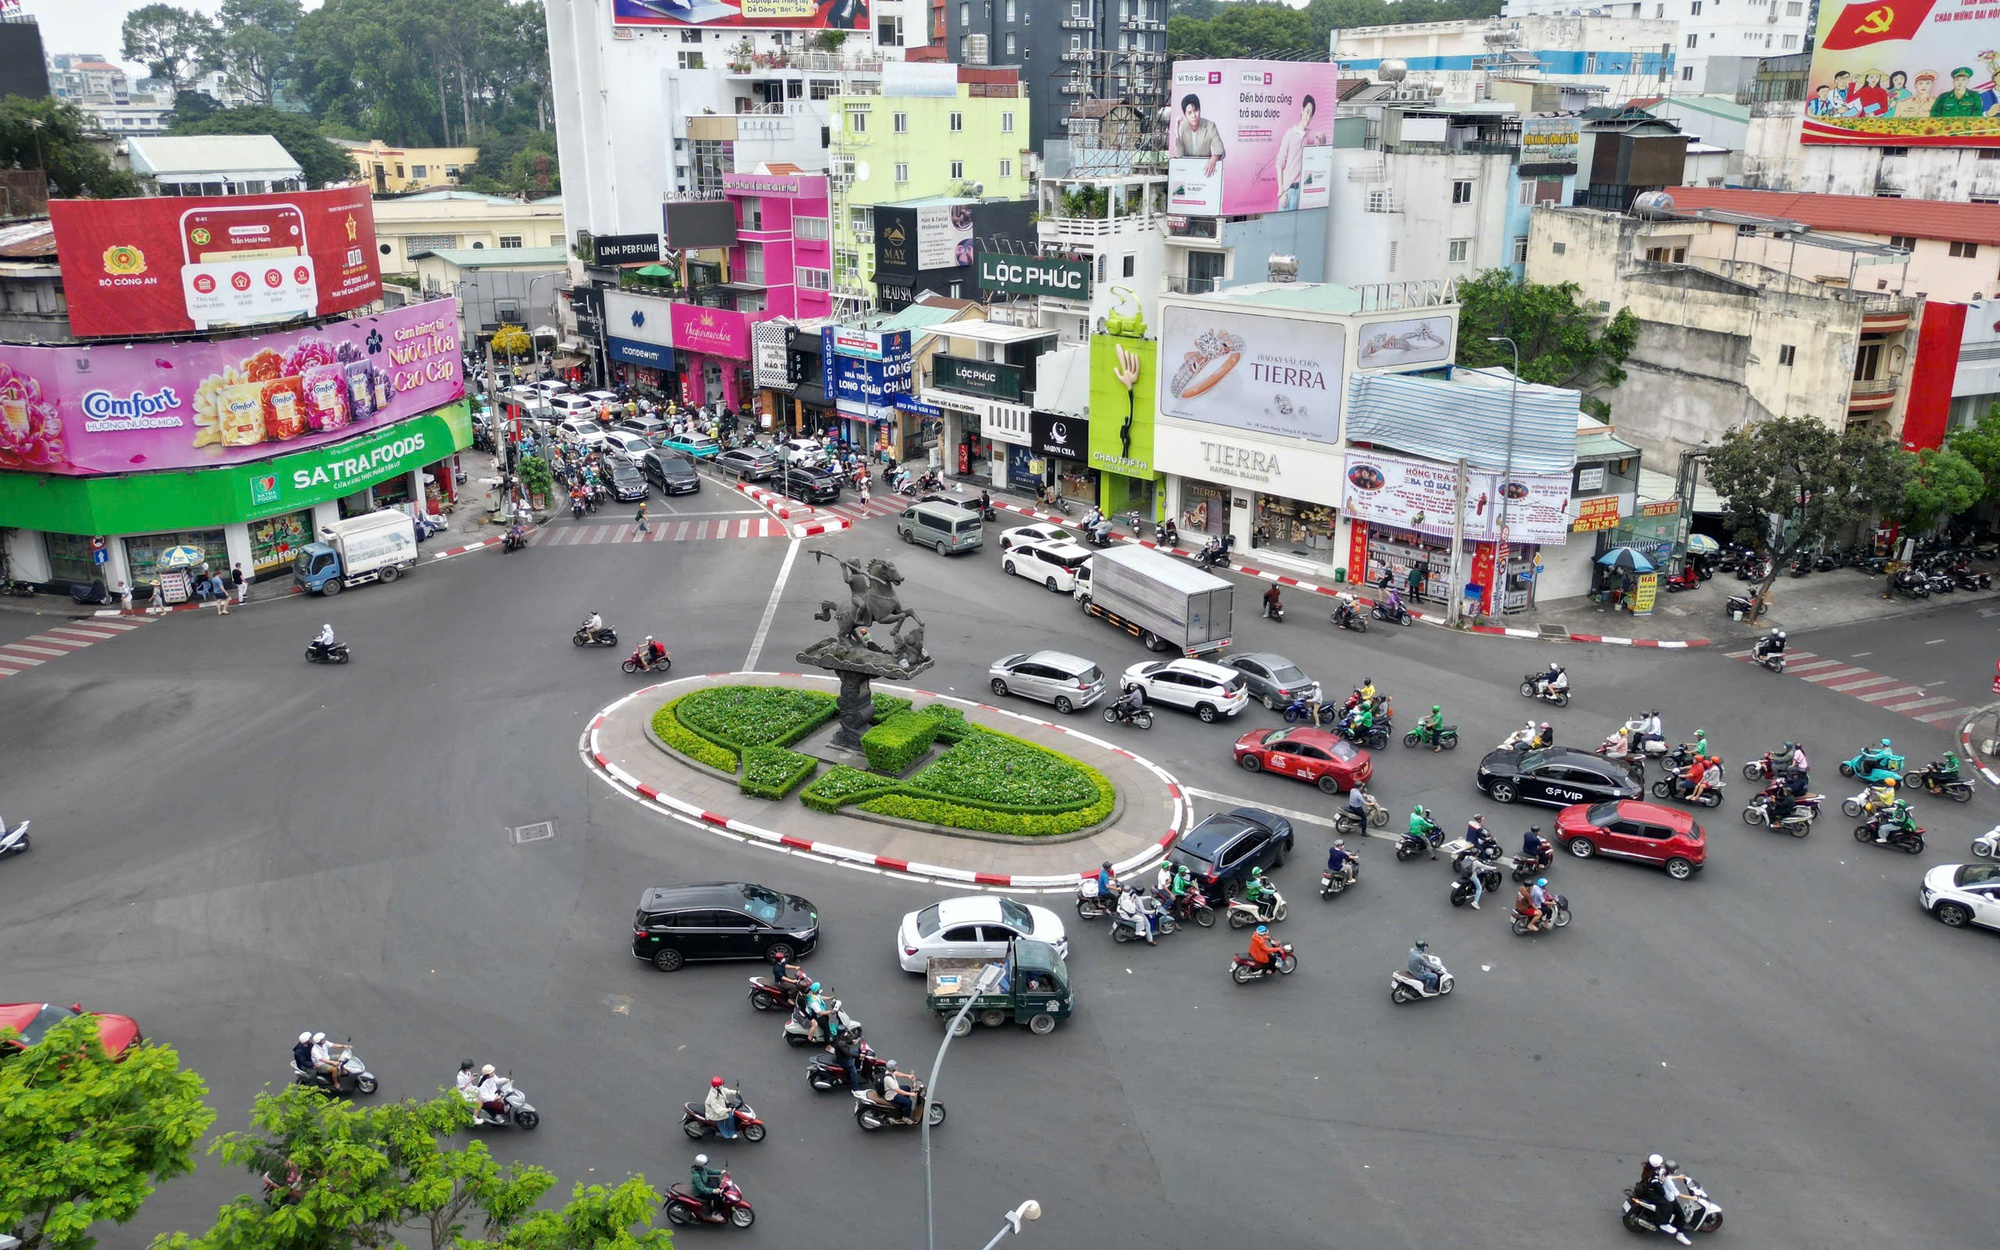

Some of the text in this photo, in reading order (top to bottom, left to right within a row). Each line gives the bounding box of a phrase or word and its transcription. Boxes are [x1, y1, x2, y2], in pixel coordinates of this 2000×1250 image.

[1240, 92, 1254, 104] Đến
[1264, 95, 1276, 104] rau
[1277, 94, 1292, 106] cũng
[1240, 108, 1280, 120] trả sau được
[600, 244, 658, 256] LINH PERFUME
[884, 248, 905, 260] MAY
[983, 260, 1082, 290] LỘC PHÚC
[99, 278, 112, 287] BỘ
[114, 277, 142, 286] CÔNG
[882, 284, 912, 302] HEAD SPA
[1354, 278, 1460, 312] TIERRA
[395, 328, 415, 341] Cảm
[388, 335, 455, 368] Nước Hoa
[883, 354, 893, 364] NHÀ
[395, 358, 454, 392] Cao Cấp
[845, 370, 855, 378] NHÀ
[883, 362, 911, 378] LONG
[956, 366, 996, 382] LỘC PHÚC
[1250, 362, 1326, 390] TIERRA
[313, 382, 336, 394] Comfort
[839, 380, 881, 395] LONG CHÂU
[84, 388, 178, 418] Comfort
[230, 400, 256, 411] Comfort
[271, 393, 296, 405] Comfort
[919, 404, 928, 413] VĂN
[87, 417, 181, 430] HƯƠNG NƯỚC HOA
[1062, 448, 1075, 456] CHA
[1200, 441, 1281, 475] TIERRA
[1209, 465, 1238, 477] NATURAL
[1432, 472, 1449, 481] TRÀ
[1192, 486, 1222, 499] TIERRA
[1546, 787, 1583, 800] GF VIP
